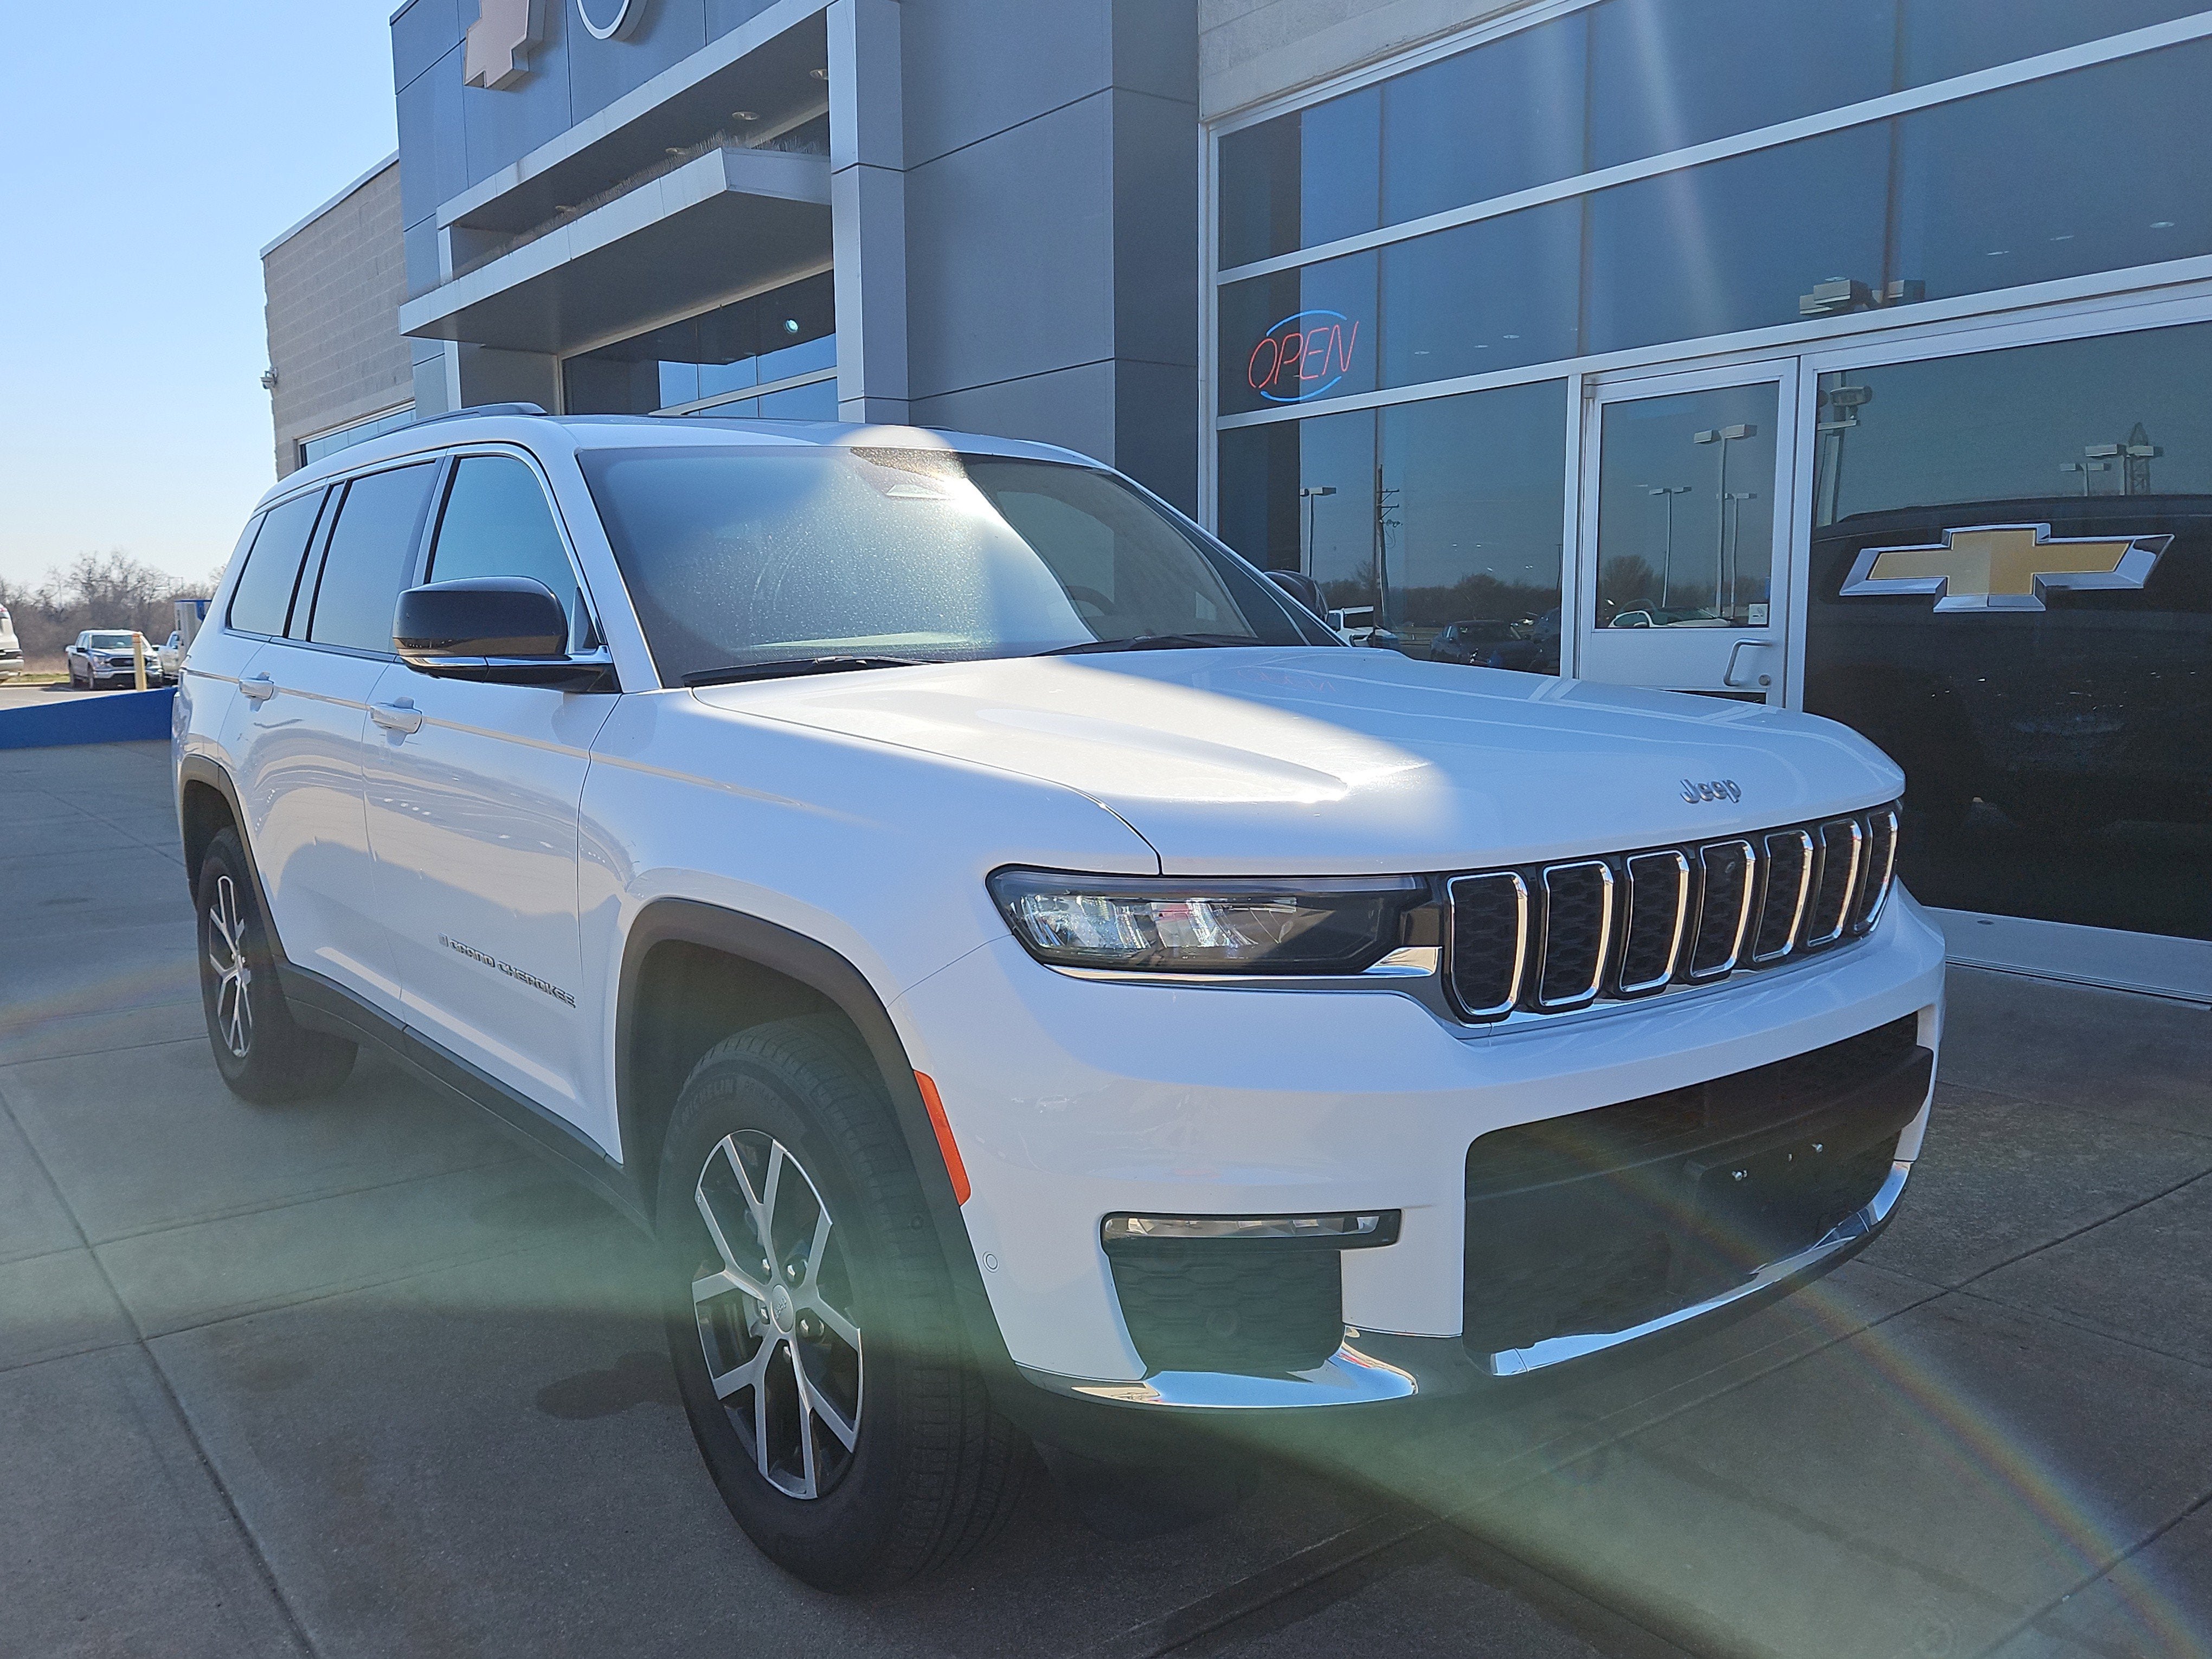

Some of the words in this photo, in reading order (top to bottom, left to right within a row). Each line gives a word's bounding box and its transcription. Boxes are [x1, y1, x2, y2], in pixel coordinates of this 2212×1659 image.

[1248, 321, 1359, 389] OPEN
[1680, 779, 1741, 804] Jeep
[497, 960, 576, 1009] CHEROKEE
